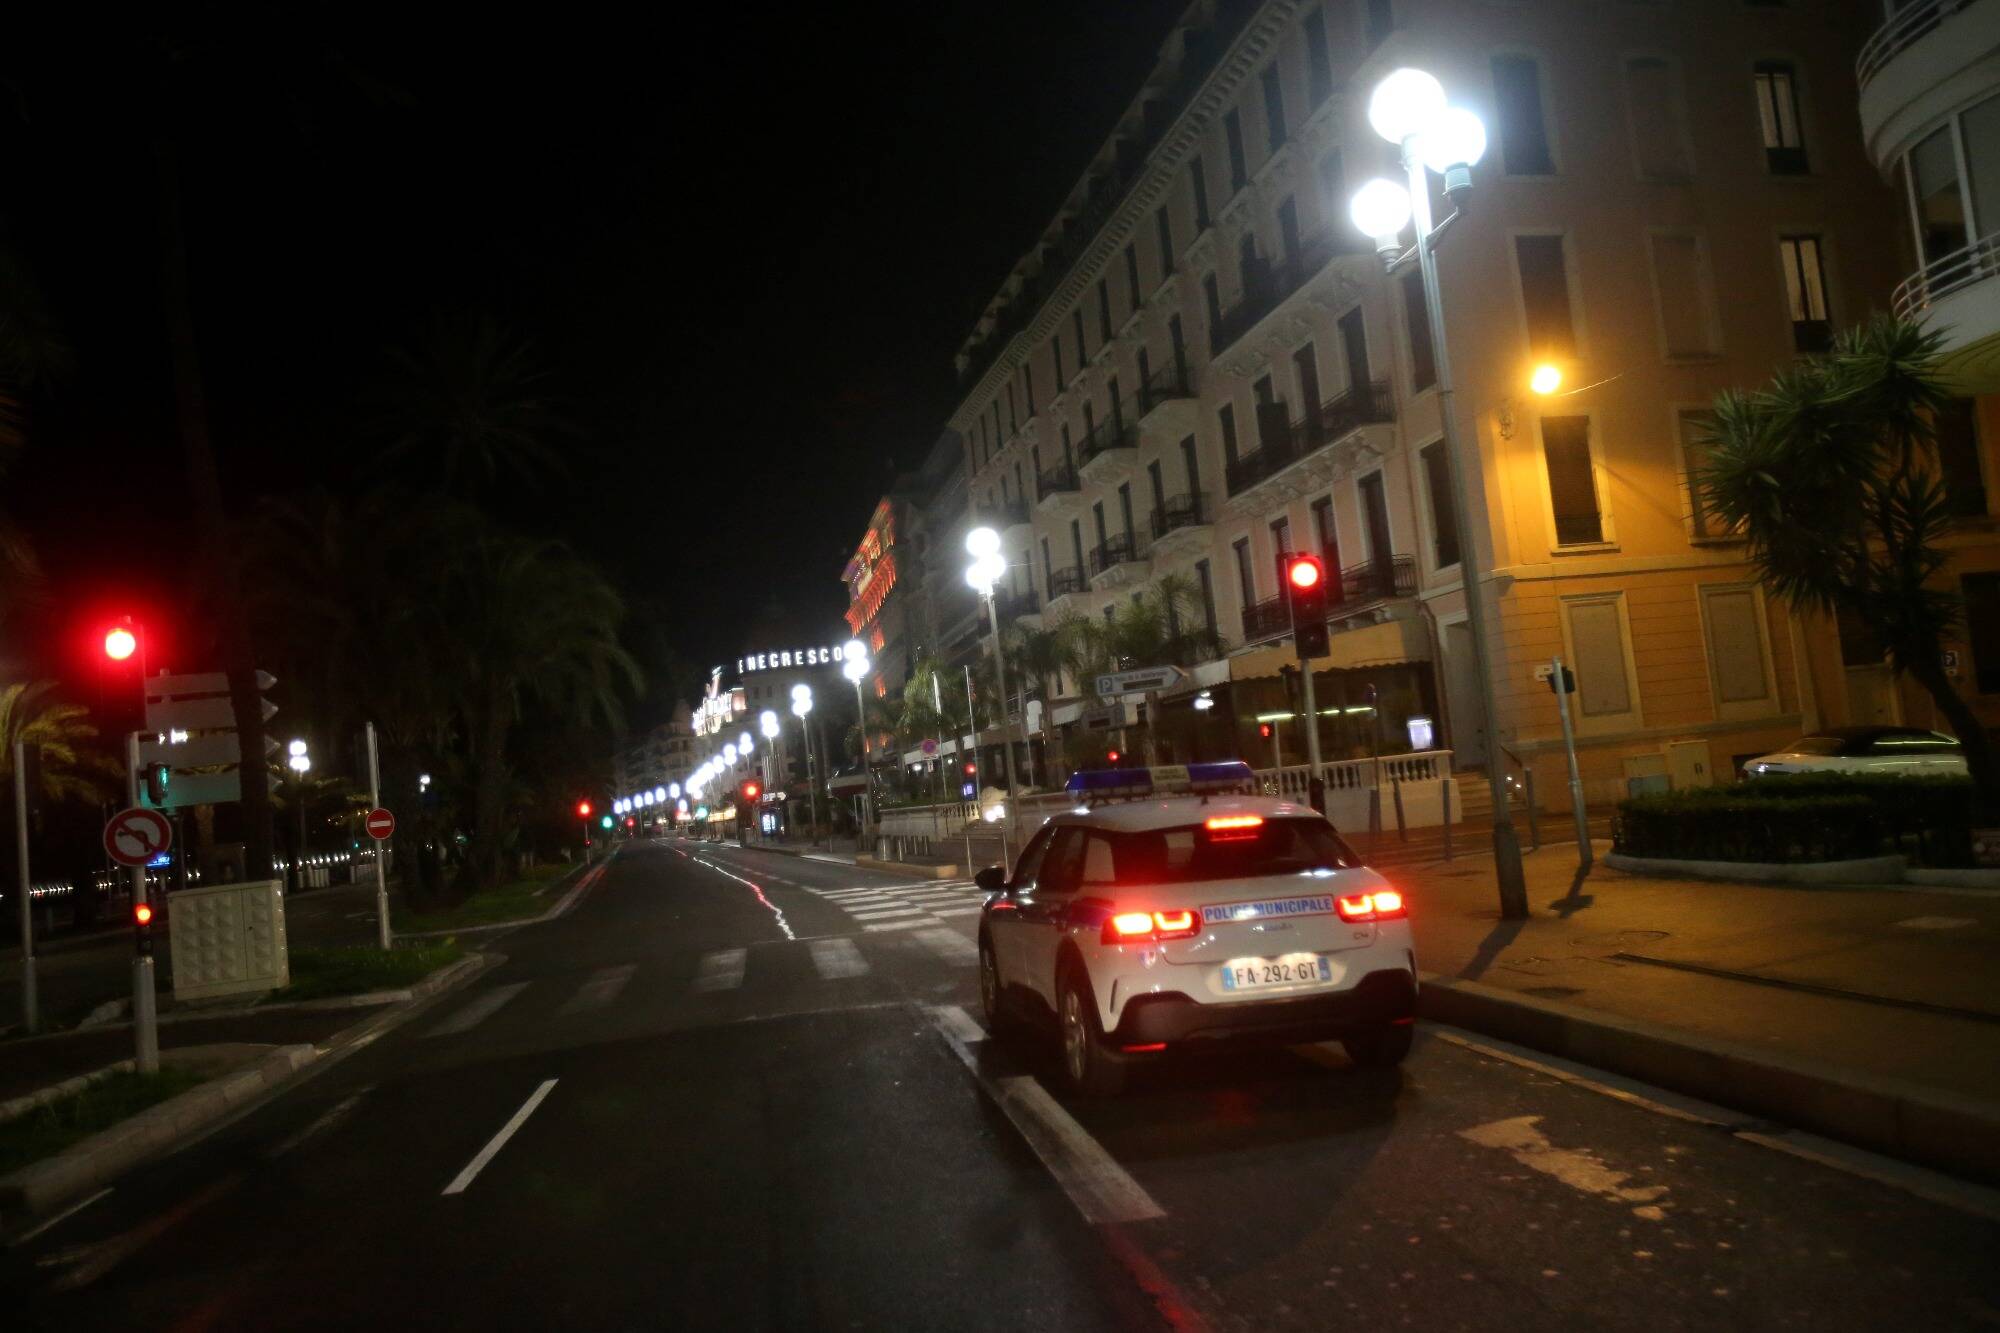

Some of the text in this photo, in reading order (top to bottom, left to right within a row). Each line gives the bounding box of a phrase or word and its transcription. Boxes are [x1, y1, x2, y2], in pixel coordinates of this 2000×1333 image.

[747, 647, 843, 670] NEGRESCO
[1102, 679, 1111, 691] P
[1254, 898, 1332, 915] MUNICIPALE
